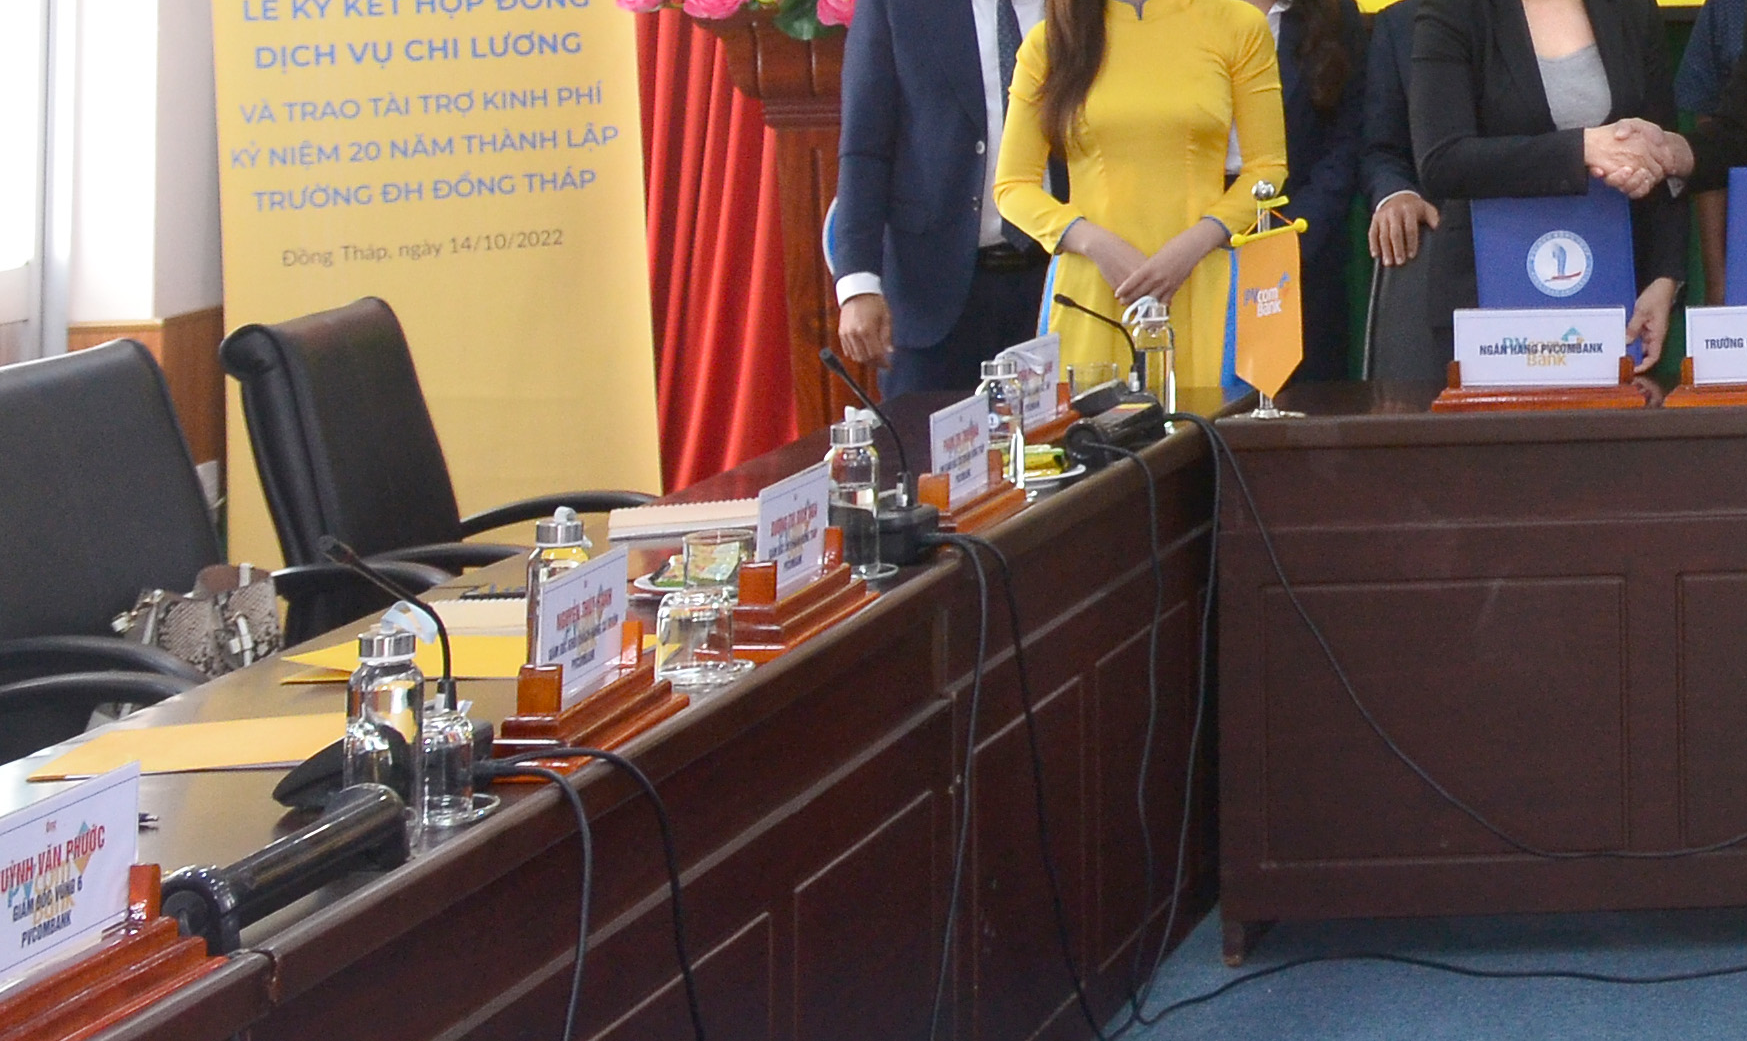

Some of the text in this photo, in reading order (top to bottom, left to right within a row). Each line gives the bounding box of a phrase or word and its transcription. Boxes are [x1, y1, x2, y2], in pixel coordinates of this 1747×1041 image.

[255, 31, 582, 75] DỊCH VỤ CHI LƯƠNG
[239, 80, 603, 124] VÀ TRAO TÀI TRỢ KINH PHÍ
[231, 122, 619, 171] KỶ NIỆM 20 NĂM THÀNH LẬP
[252, 182, 373, 212] TRƯỜNG
[381, 181, 423, 204] ĐH
[523, 165, 596, 193] THÁP
[282, 249, 334, 268] Đồng
[398, 239, 442, 260] ngày
[450, 228, 563, 255] 14/10/2022
[1541, 342, 1603, 354] PVCOMBANK
[1705, 336, 1743, 349] TRƯỜNG
[0, 824, 105, 893] UỲNH VĂN PHƯỚC
